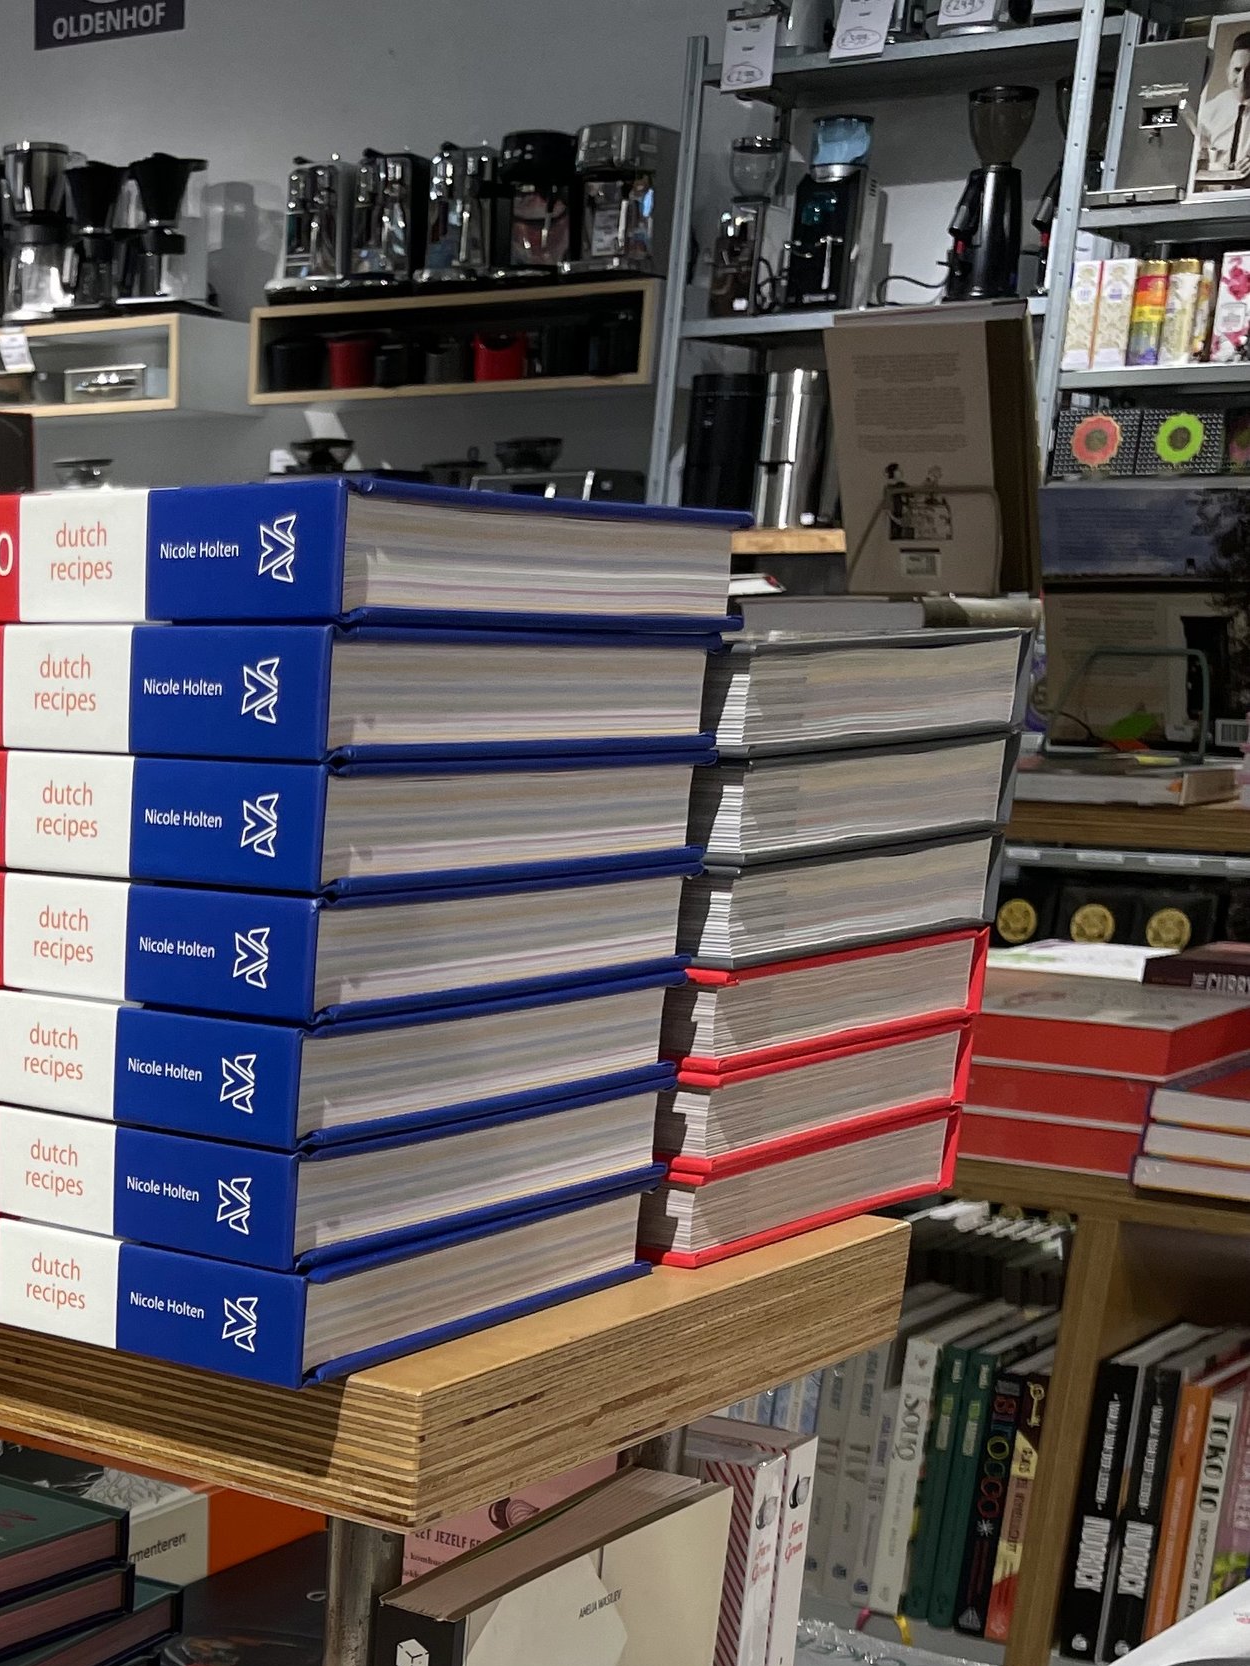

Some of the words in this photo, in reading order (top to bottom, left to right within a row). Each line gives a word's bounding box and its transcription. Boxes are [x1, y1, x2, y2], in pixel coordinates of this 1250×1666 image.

[52, 2, 167, 40] OLDENHOF
[55, 521, 107, 548] dutch
[160, 543, 197, 559] Nicole
[199, 541, 239, 558] Holten
[50, 556, 112, 584] recipes
[39, 653, 91, 679] dutch
[34, 686, 96, 715] recipes
[42, 780, 93, 806] dutch
[36, 812, 98, 840] recipes
[38, 905, 89, 932] dutch
[33, 934, 94, 963] recipes
[139, 936, 175, 954] Nicole
[177, 940, 215, 958] Holten
[29, 1022, 79, 1051] dutch
[23, 1051, 84, 1080] recipes
[30, 1138, 78, 1168] dutch
[24, 1164, 84, 1195] recipes
[31, 1252, 81, 1282] dutch
[25, 1277, 86, 1308] recipes
[129, 1290, 164, 1312] Nicole
[167, 1297, 205, 1319] Holten
